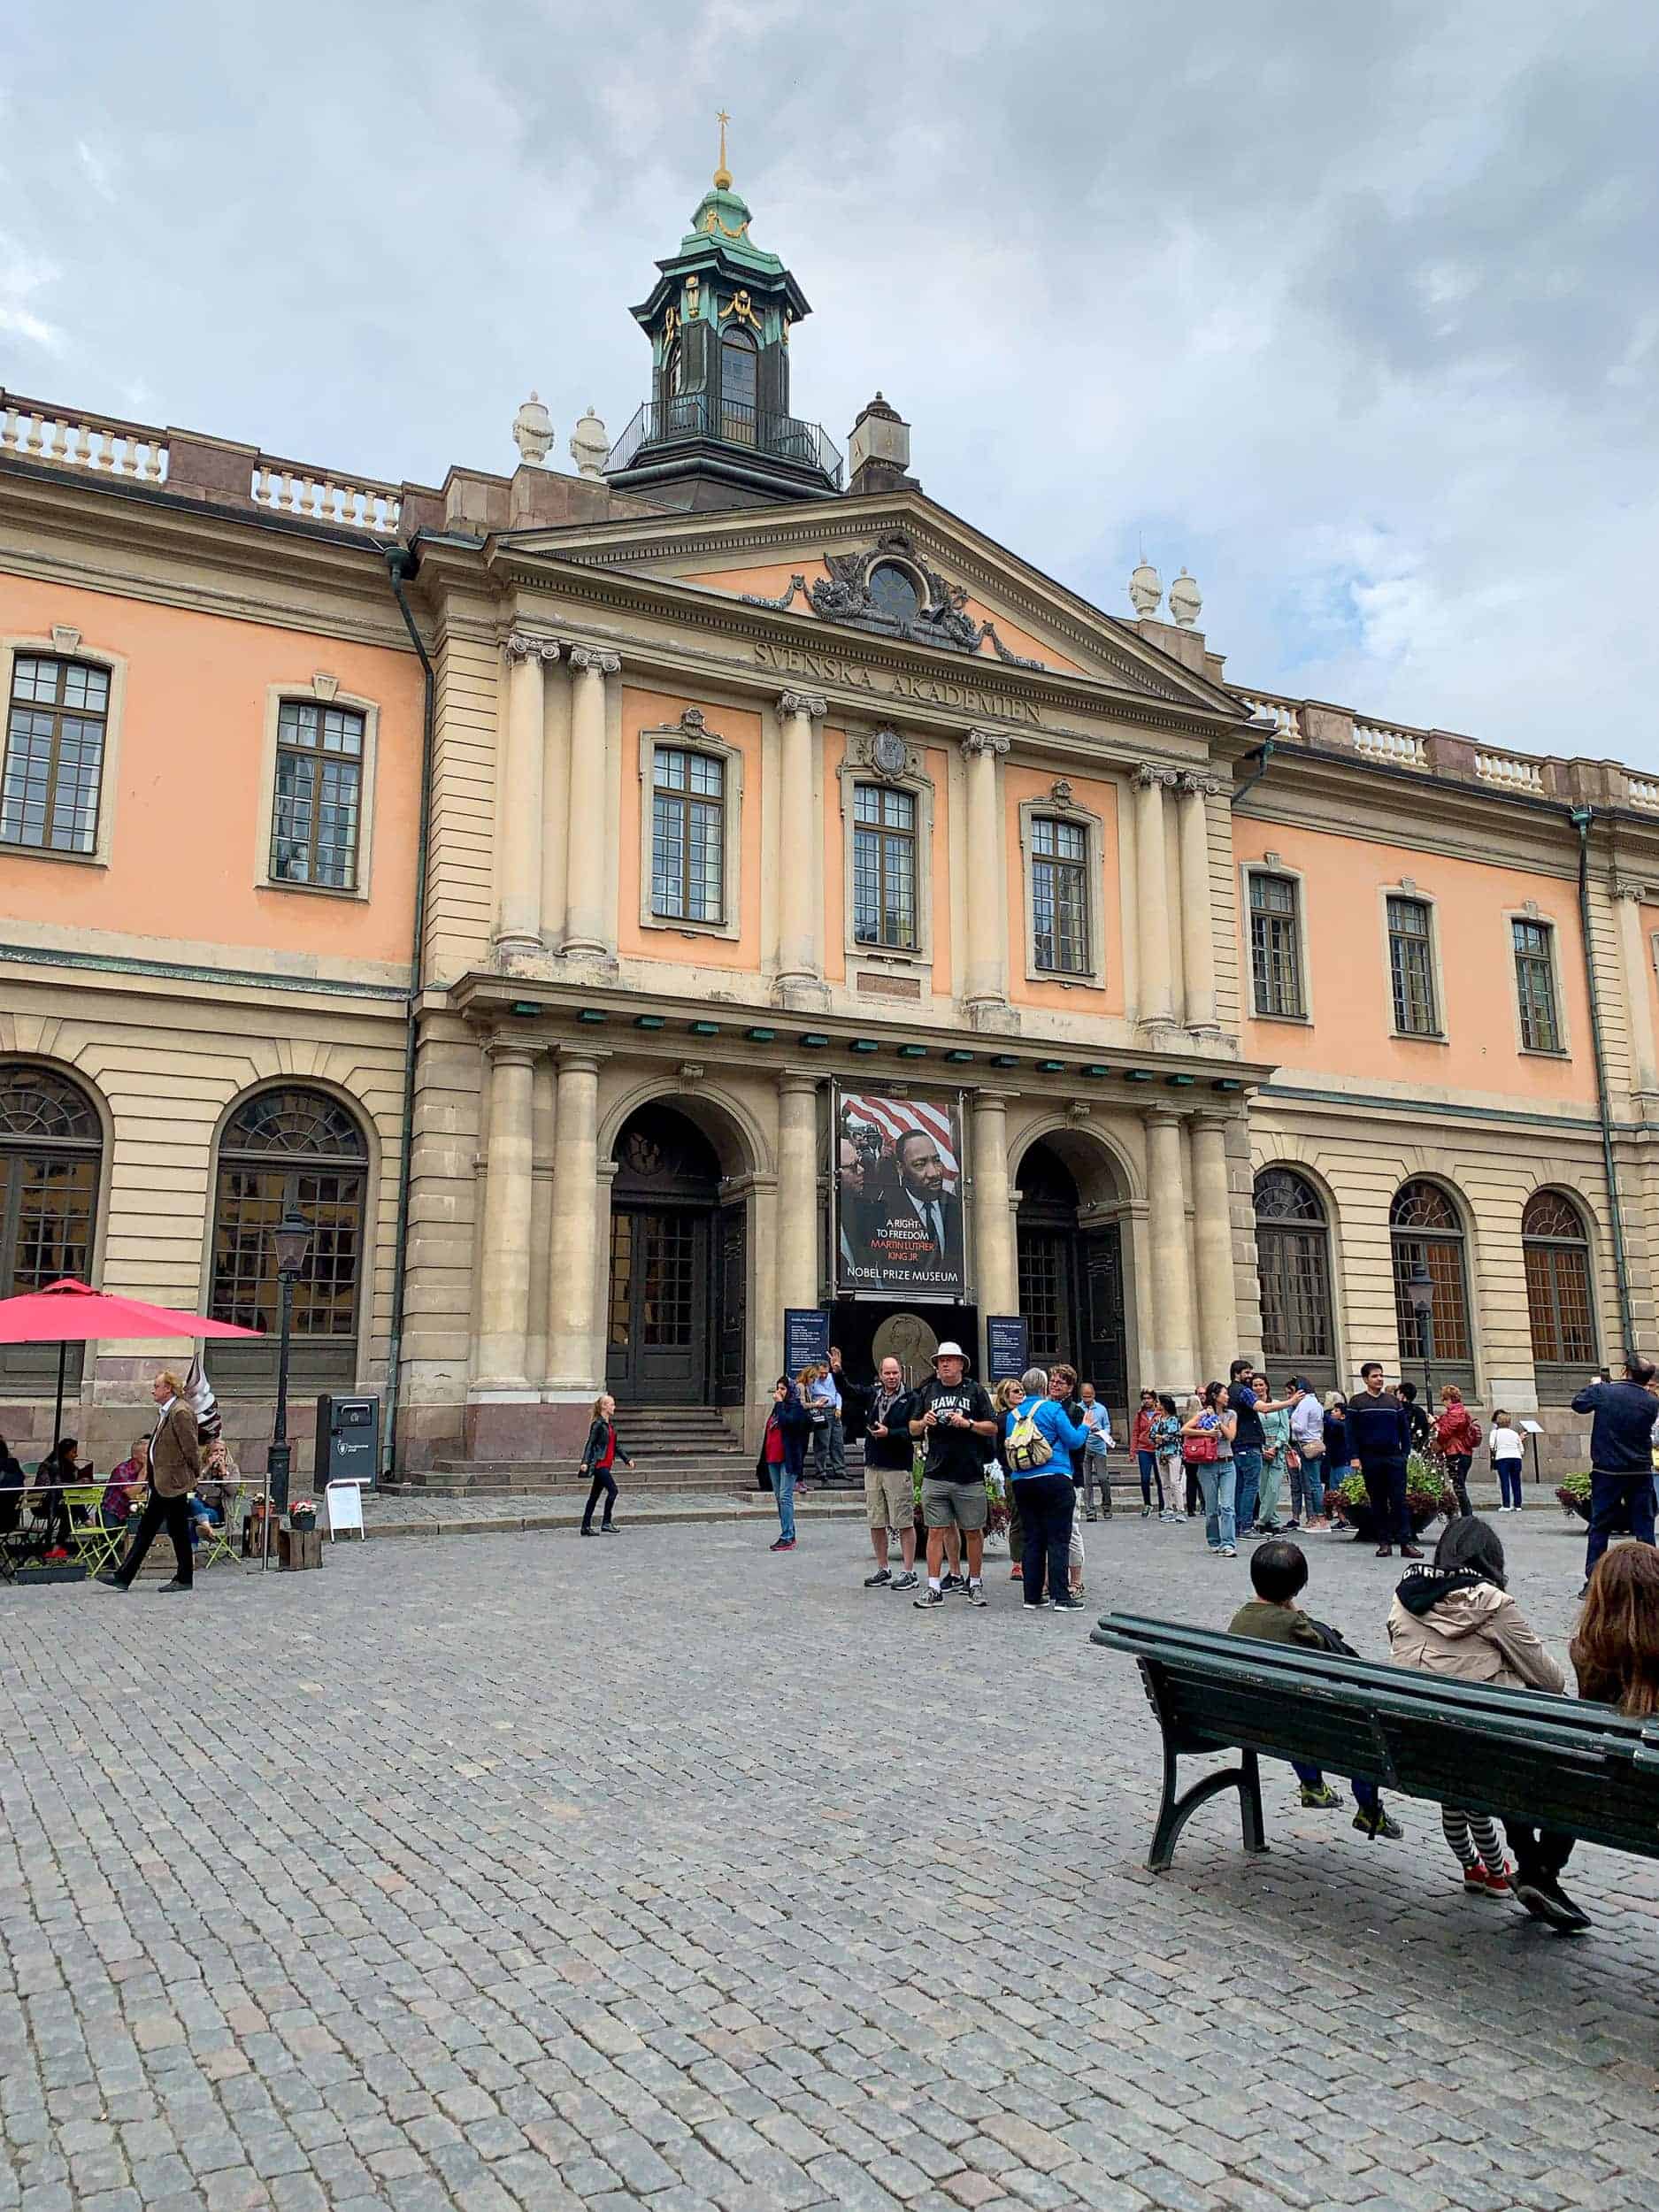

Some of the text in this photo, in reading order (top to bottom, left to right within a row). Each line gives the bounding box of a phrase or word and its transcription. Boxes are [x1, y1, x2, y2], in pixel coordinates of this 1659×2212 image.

[755, 642, 1041, 724] SVENSKA AKADEMIEN
[895, 1219, 918, 1229] RIGHT
[876, 1228, 929, 1240] TO FREEDOM
[871, 1240, 935, 1251] MARTIN LUTHER
[887, 1251, 918, 1262] KING JR
[847, 1266, 958, 1282] NOBEL PRIZE MUSEUM
